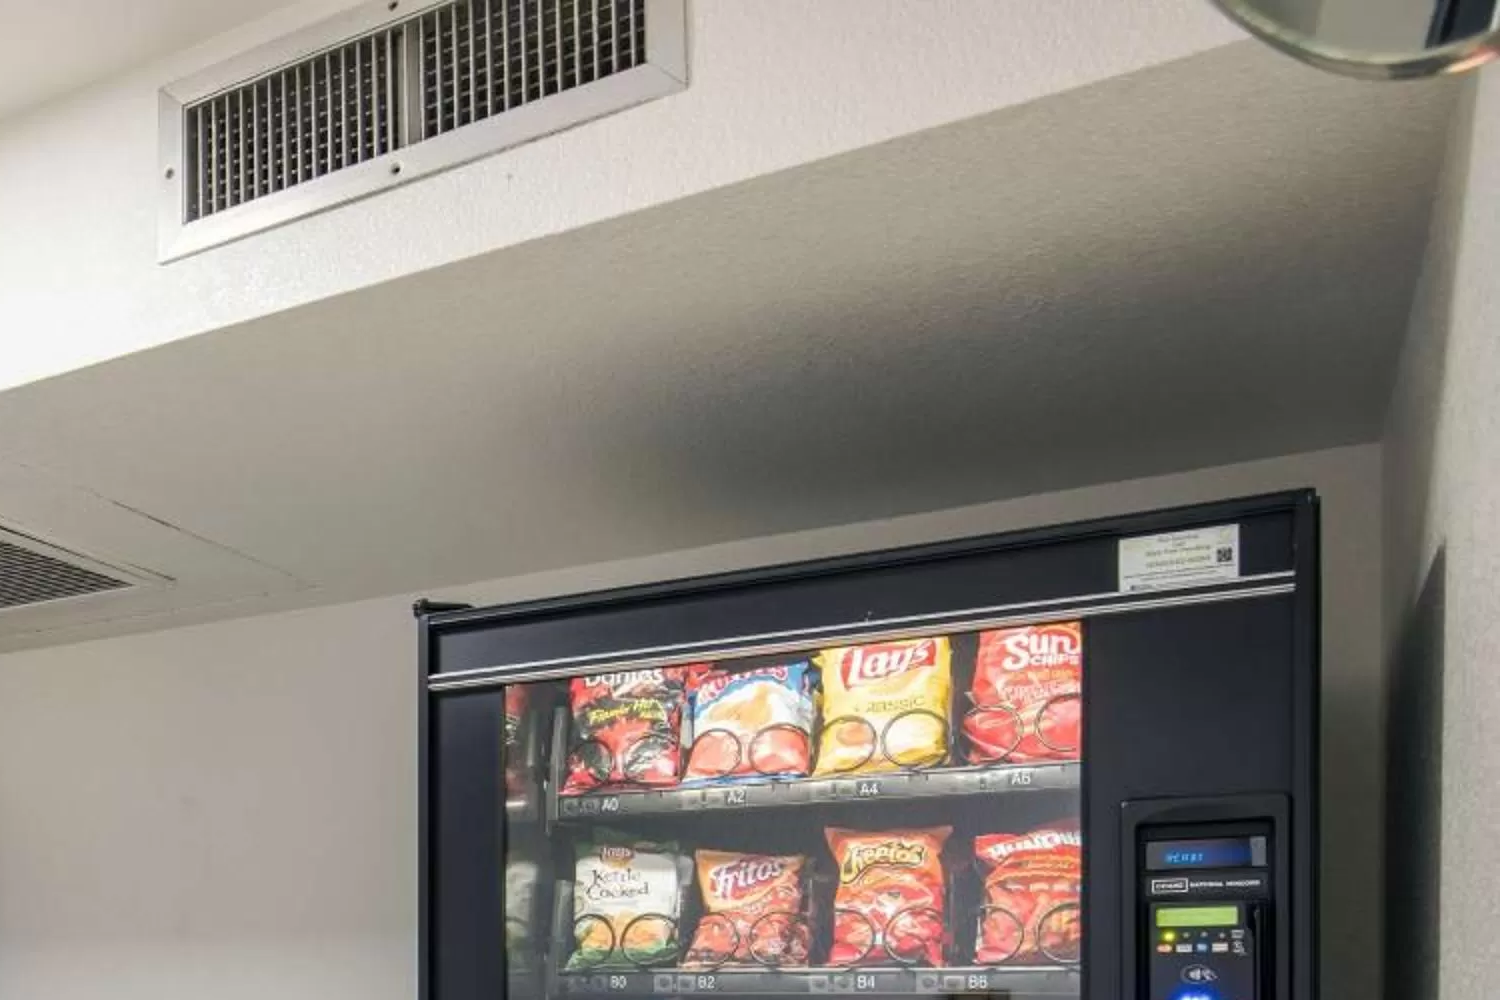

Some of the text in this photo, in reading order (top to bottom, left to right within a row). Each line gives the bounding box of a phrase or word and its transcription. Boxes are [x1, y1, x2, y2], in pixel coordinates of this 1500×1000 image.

[1003, 632, 1073, 672] Sun
[860, 782, 878, 795] A4
[727, 790, 745, 804] A2
[711, 858, 785, 900] Fritos
[697, 975, 715, 989] B2
[856, 975, 876, 989] B4
